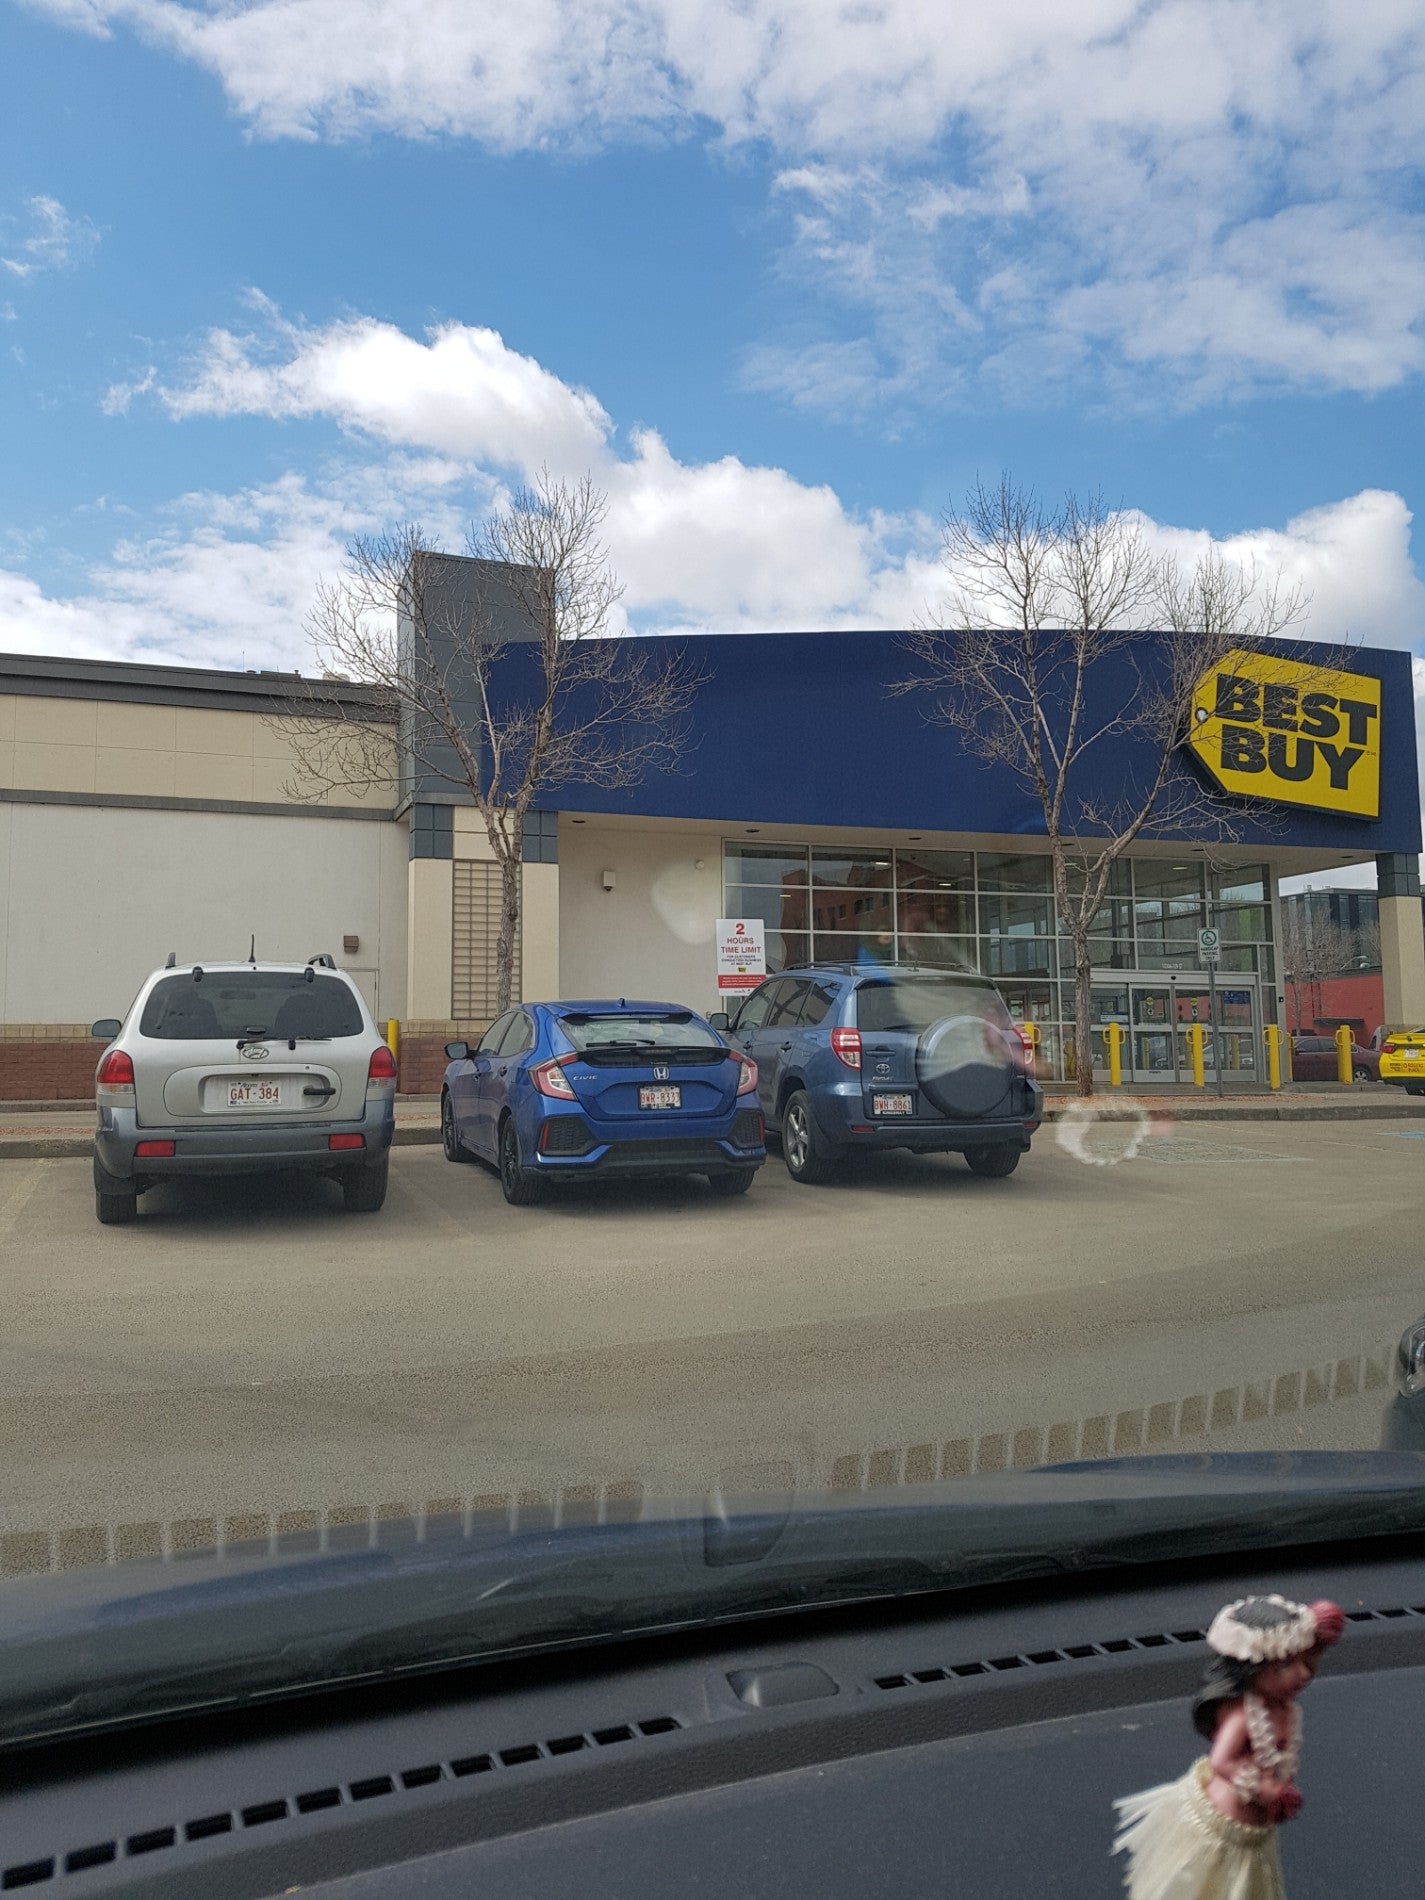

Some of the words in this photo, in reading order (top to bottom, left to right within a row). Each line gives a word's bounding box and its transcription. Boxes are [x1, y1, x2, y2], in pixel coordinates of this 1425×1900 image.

[1215, 672, 1378, 745] BEST
[1221, 723, 1366, 790] BUY
[736, 923, 745, 935] 2
